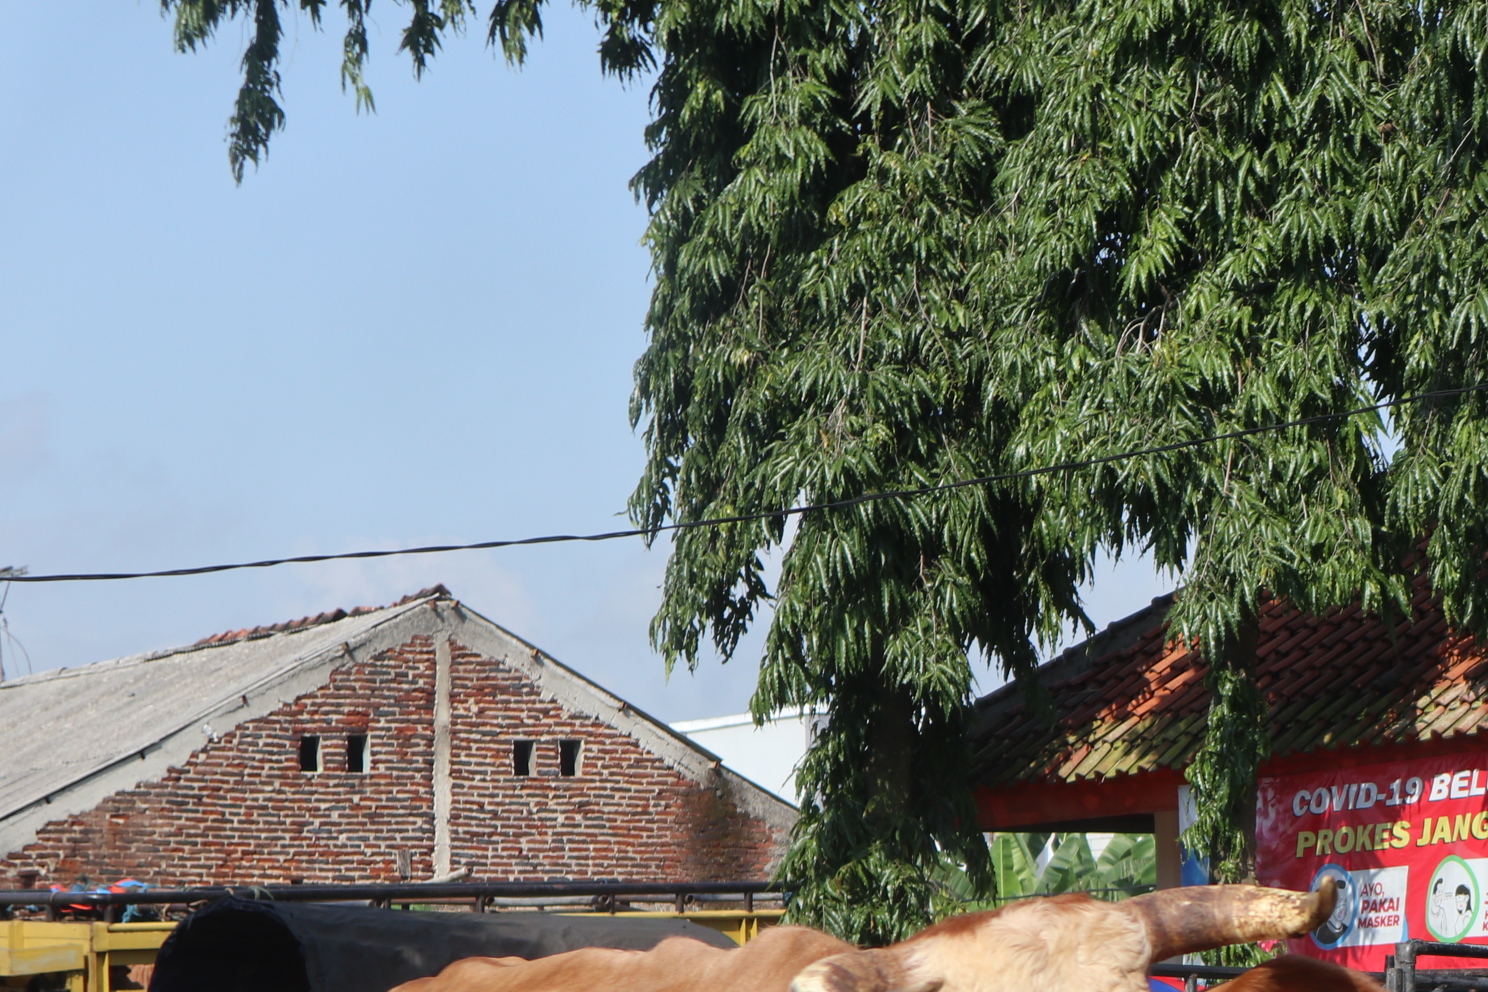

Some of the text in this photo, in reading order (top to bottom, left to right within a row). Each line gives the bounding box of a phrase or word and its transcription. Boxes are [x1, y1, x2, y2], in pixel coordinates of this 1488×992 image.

[1293, 776, 1423, 817] COVID-19
[1295, 820, 1412, 859] PROKES
[1360, 882, 1385, 898] AYO,
[1361, 896, 1400, 915] PAKAI
[1357, 914, 1400, 930] MASKER
